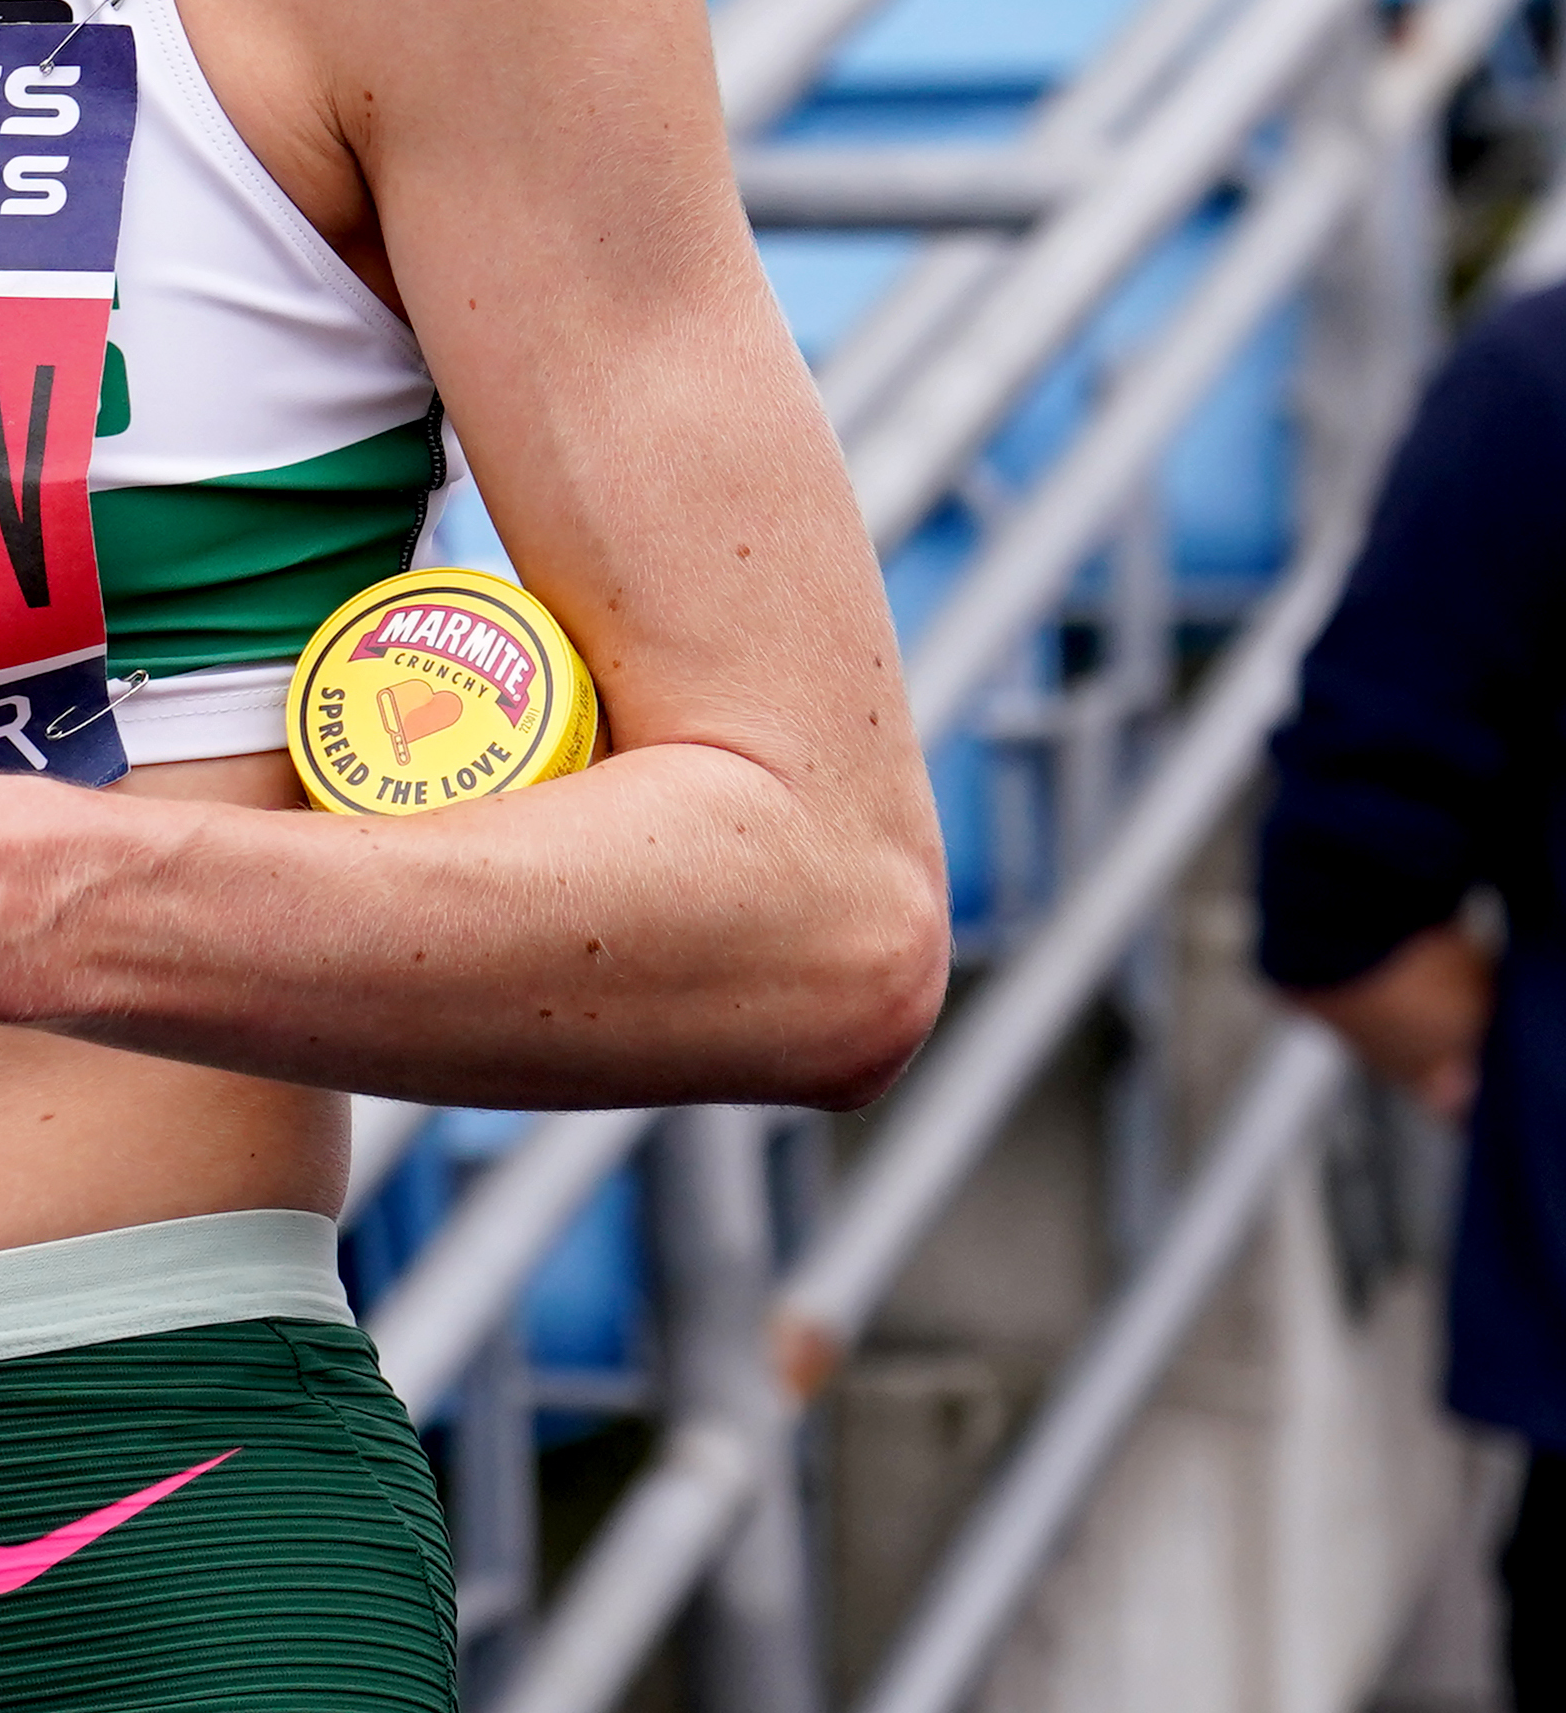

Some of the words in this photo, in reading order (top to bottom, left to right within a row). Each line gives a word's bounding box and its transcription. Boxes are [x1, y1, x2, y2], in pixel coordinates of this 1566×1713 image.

[377, 608, 530, 697] MARMITE
[393, 652, 490, 700] CRUNCHY
[318, 686, 370, 787] SPREAD
[375, 775, 429, 806] THE
[440, 740, 513, 800] LOVE
